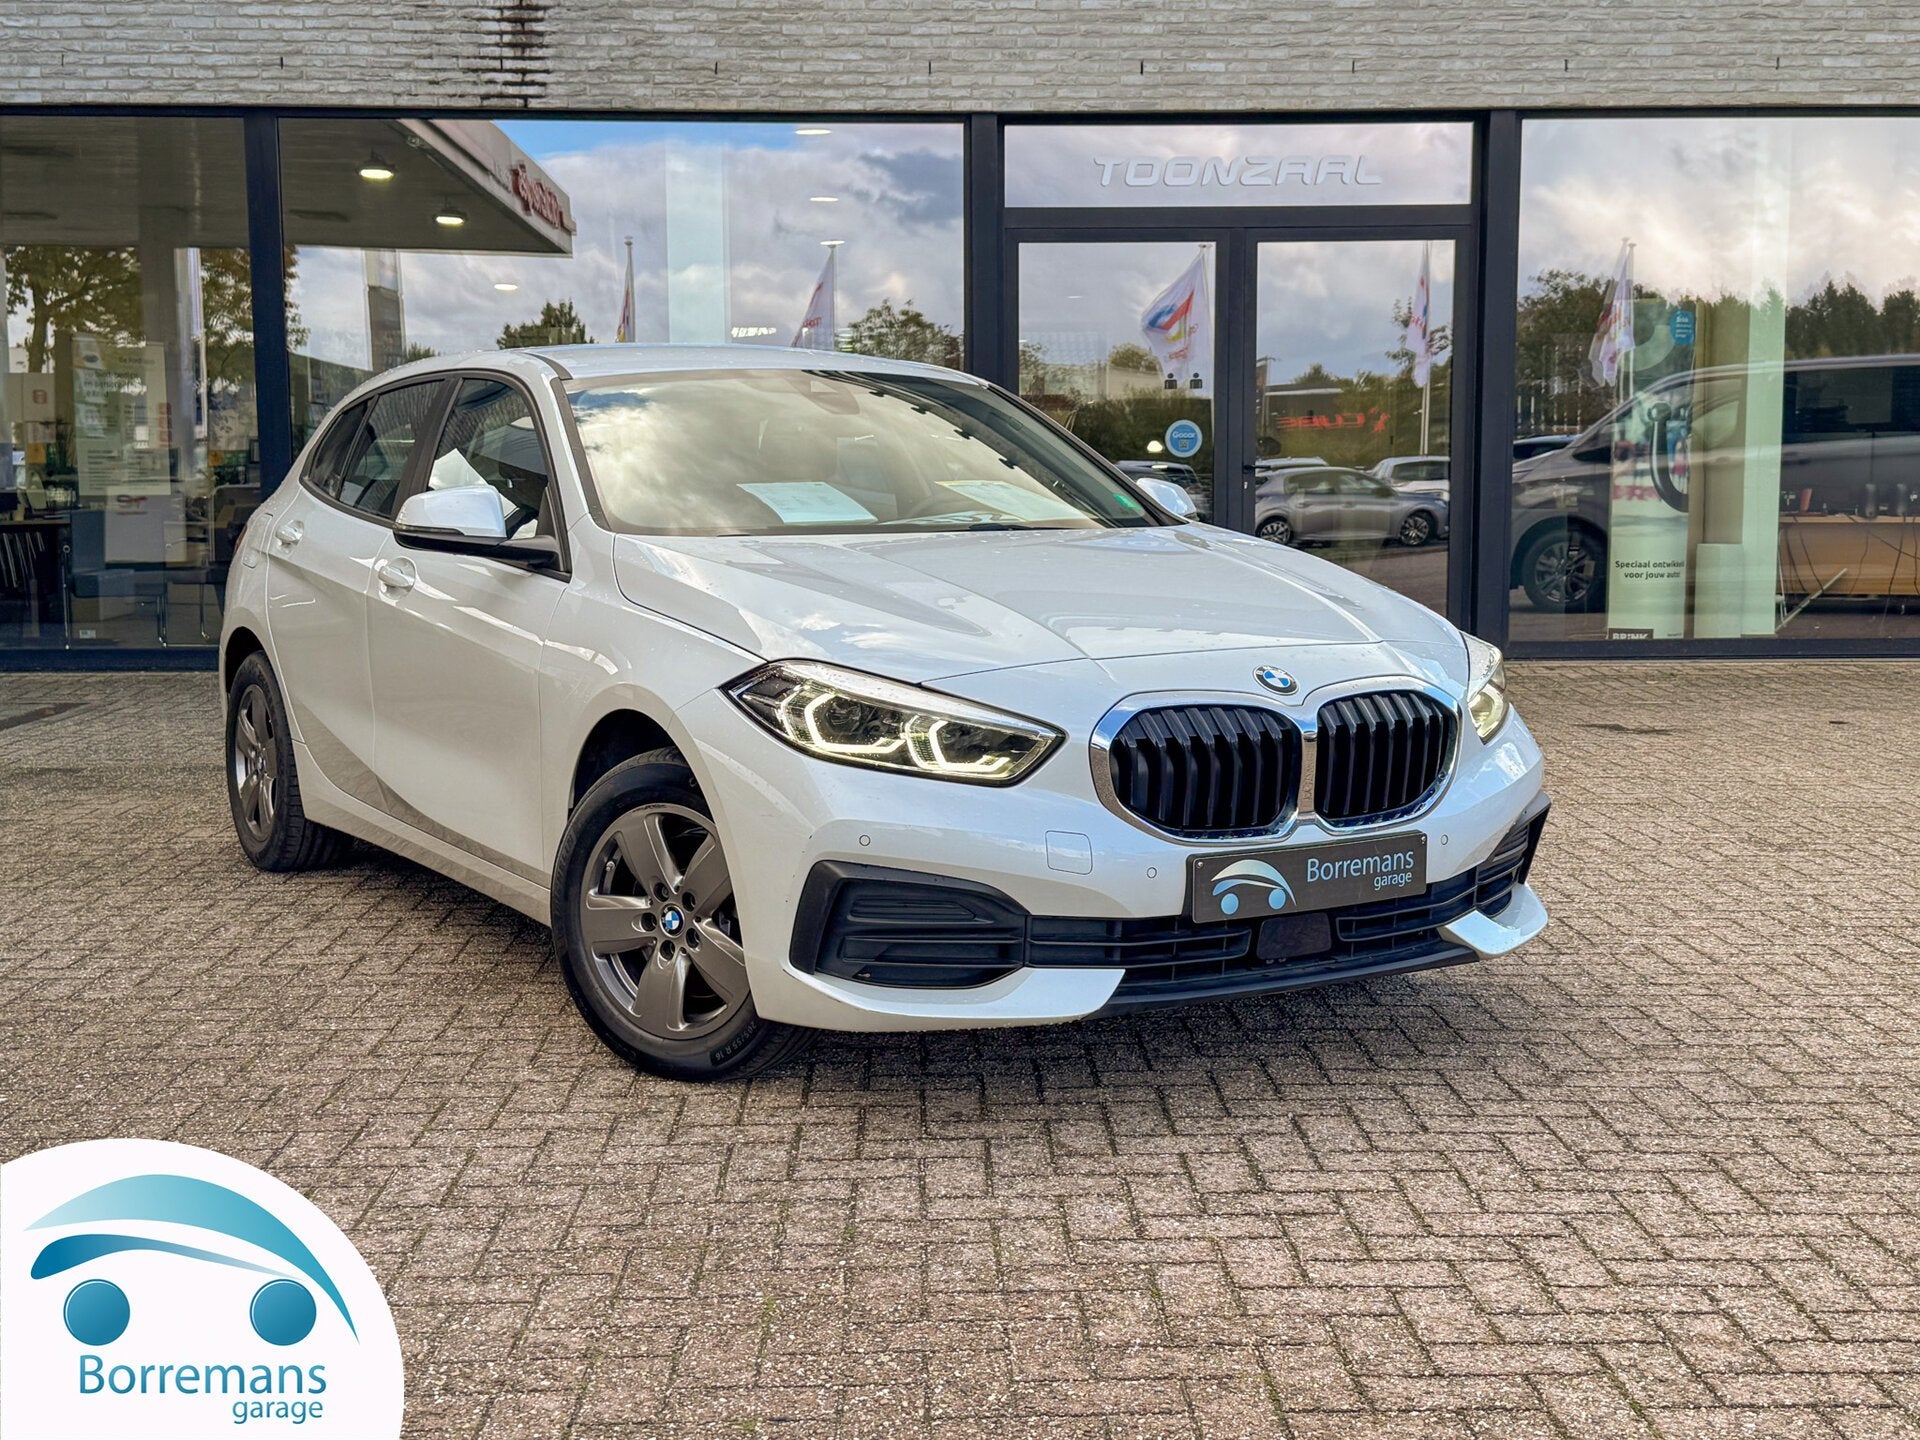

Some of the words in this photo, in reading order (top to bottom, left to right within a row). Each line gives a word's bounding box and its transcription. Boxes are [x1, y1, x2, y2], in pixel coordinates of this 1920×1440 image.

[1093, 155, 1383, 187] TOONZAAL
[1615, 560, 1651, 569] Speciaal
[1645, 571, 1665, 580] jouw
[1307, 851, 1414, 882] Borremans
[1374, 872, 1412, 891] garage
